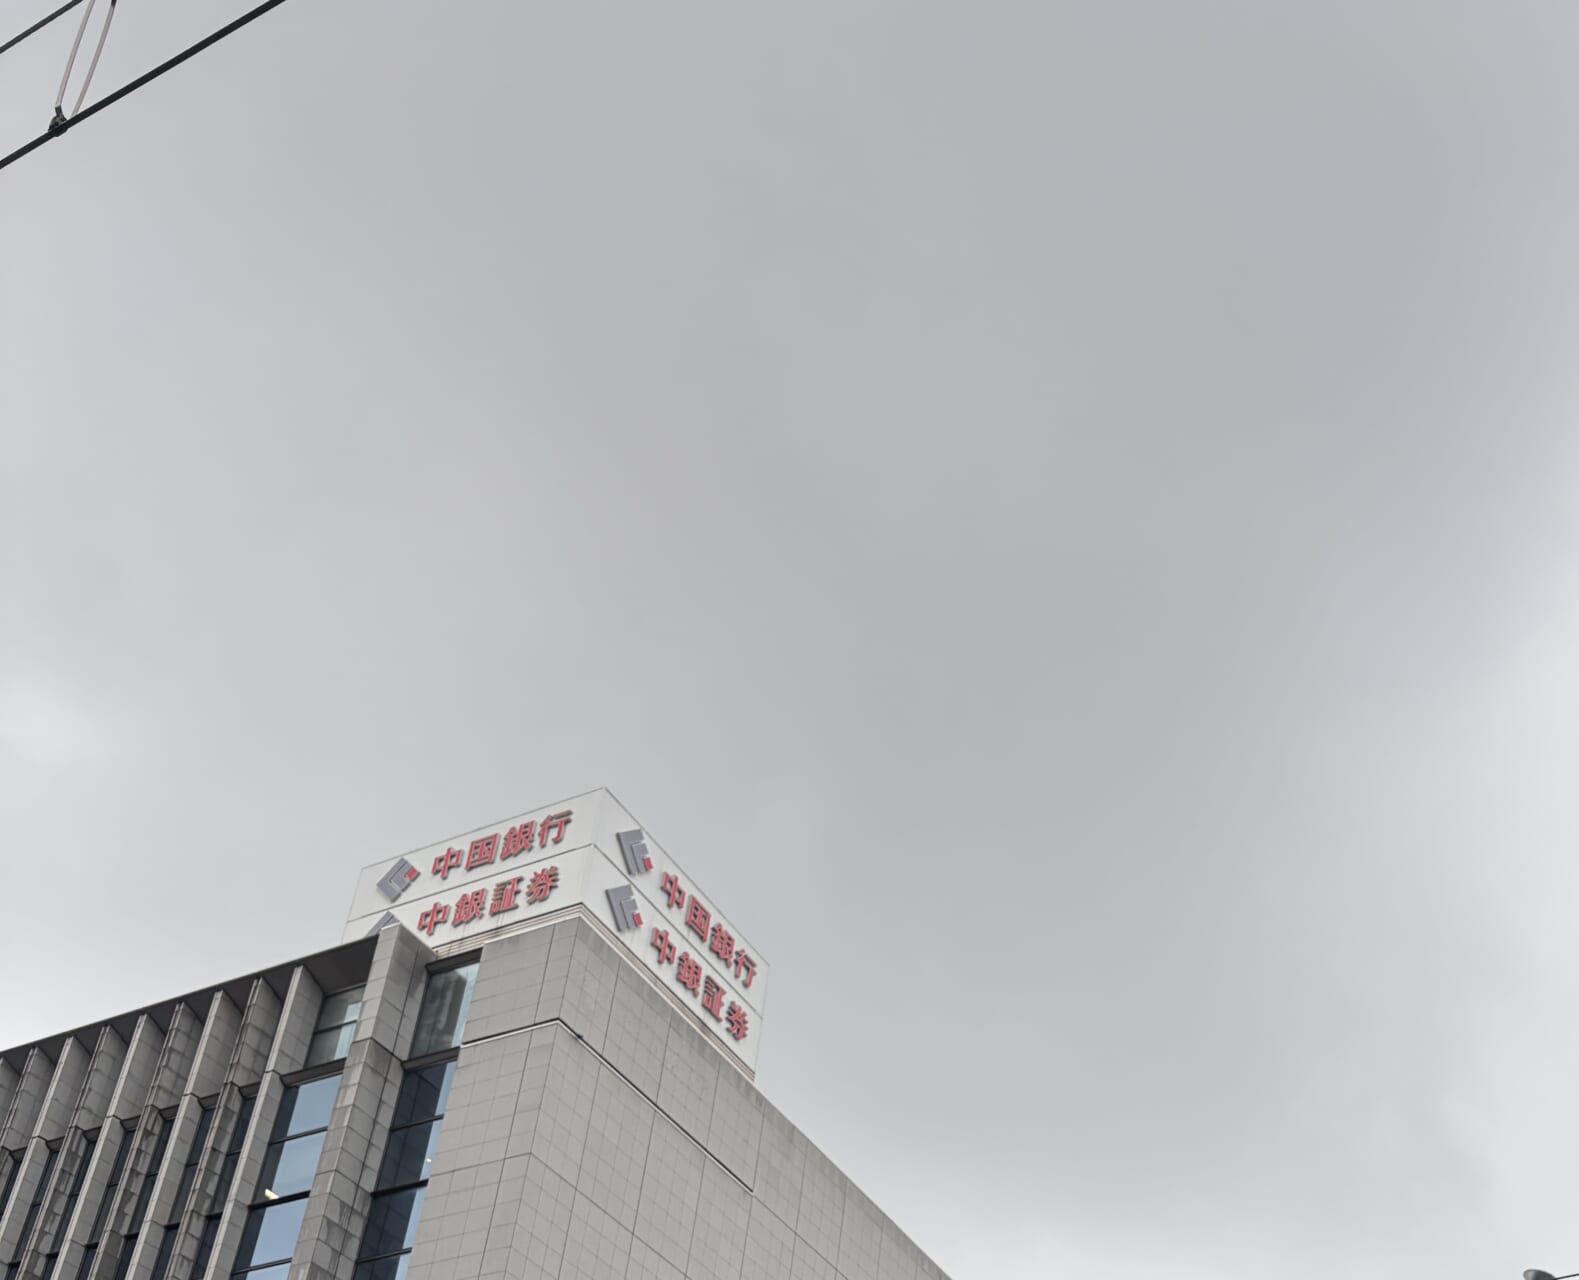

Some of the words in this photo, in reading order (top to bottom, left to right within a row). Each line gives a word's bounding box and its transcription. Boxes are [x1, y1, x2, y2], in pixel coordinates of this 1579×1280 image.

[431, 809, 573, 880] 中国銀行
[417, 865, 559, 936] 中銀証券
[660, 871, 758, 989] 中国銀行
[650, 927, 749, 1042] 中銀証券
